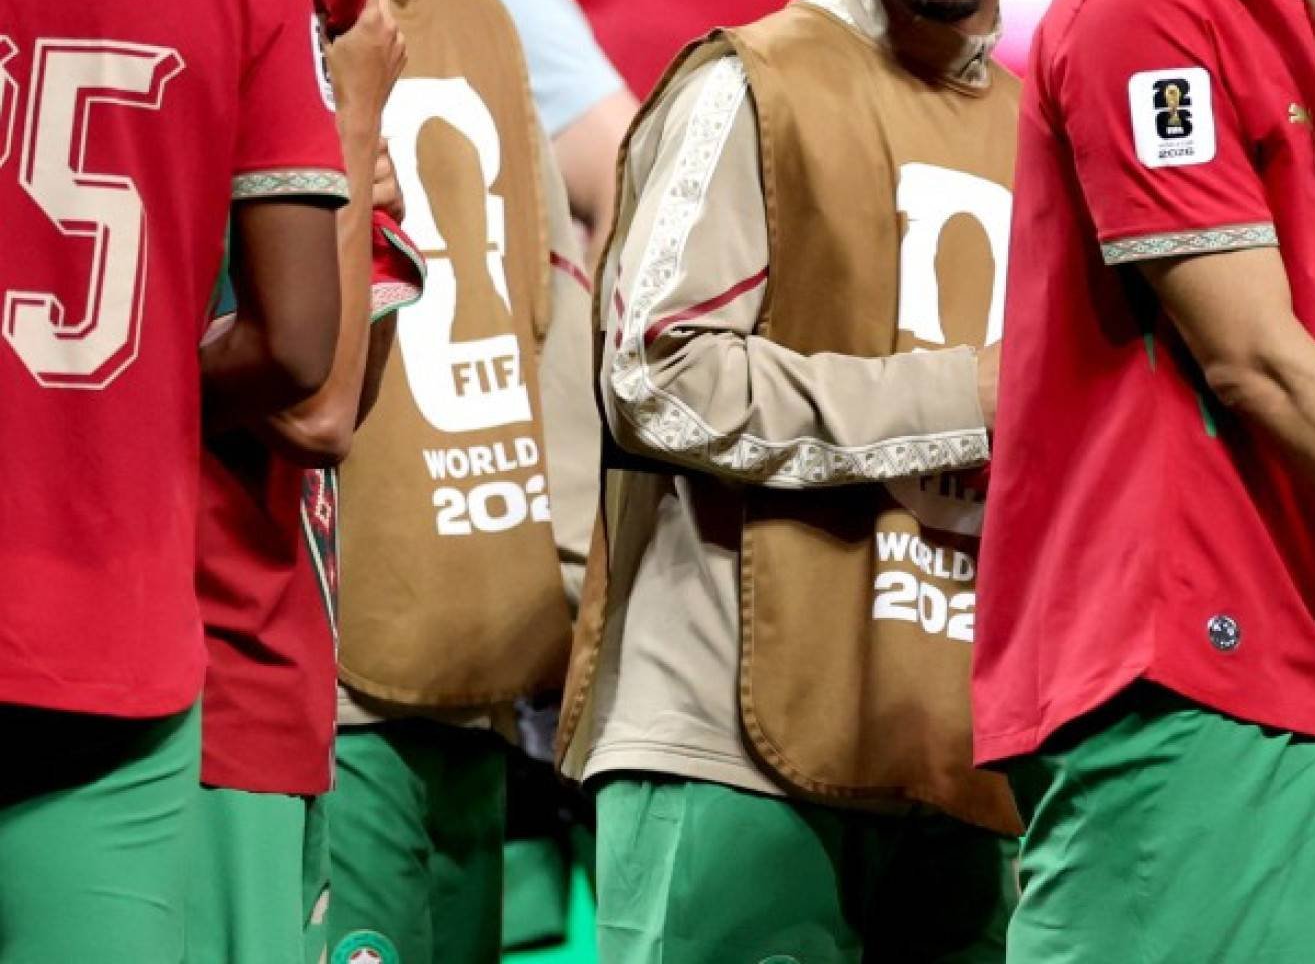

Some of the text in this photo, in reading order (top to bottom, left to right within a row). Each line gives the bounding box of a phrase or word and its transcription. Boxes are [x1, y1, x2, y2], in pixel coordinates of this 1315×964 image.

[0, 36, 186, 390] 5
[451, 354, 524, 397] FIF
[423, 437, 540, 481] WORLD
[876, 531, 976, 582] WORLD
